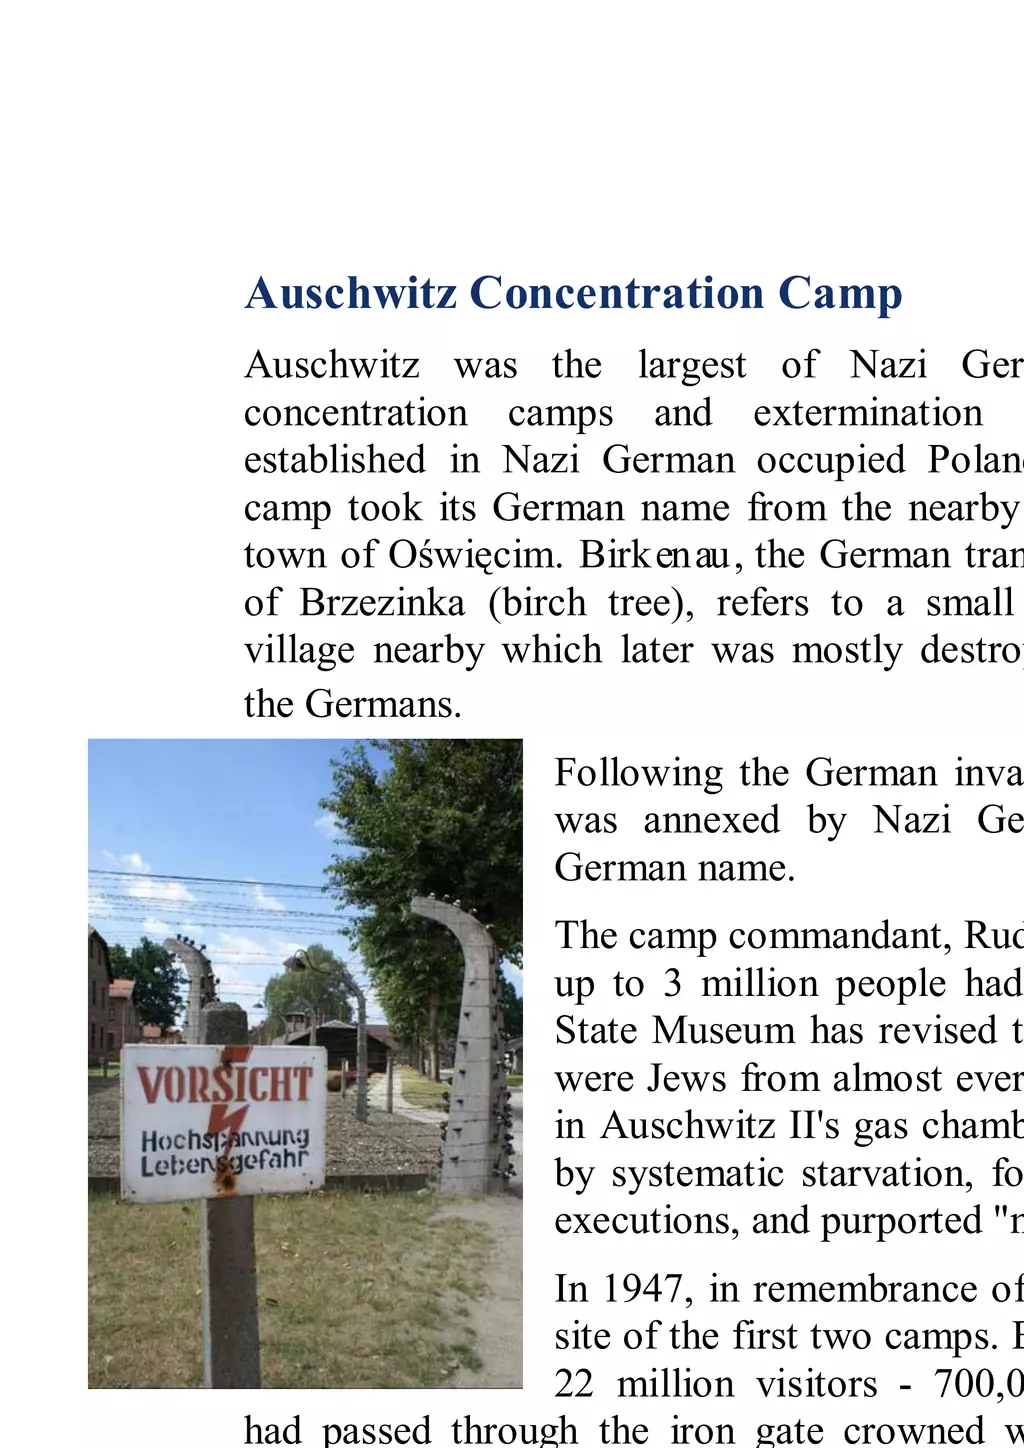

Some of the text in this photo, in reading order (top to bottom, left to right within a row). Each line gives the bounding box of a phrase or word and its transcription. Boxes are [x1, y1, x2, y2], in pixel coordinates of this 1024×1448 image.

[243, 275, 902, 319] Auschwitz Concentration Camp
[243, 348, 420, 379] Auschwitz
[453, 357, 518, 379] was
[551, 348, 602, 379] the
[638, 348, 747, 387] largest
[782, 348, 822, 379] of
[848, 348, 927, 379] Nazi
[244, 395, 469, 427] concentration
[508, 405, 614, 435] camps
[654, 396, 713, 427] and
[754, 395, 984, 427] extermination
[244, 443, 427, 474] established
[450, 443, 481, 474] in
[501, 443, 580, 474] Nazi
[602, 443, 736, 474] German
[757, 443, 907, 482] occupied
[243, 542, 327, 569] town
[341, 538, 381, 569] of
[389, 538, 563, 576] Oświęcim.
[579, 538, 743, 575] Birkenau,
[754, 538, 805, 569] the
[820, 538, 952, 569] German
[243, 633, 355, 672] village
[373, 633, 486, 672] nearby
[501, 633, 603, 664] which
[621, 633, 695, 664] later
[710, 642, 775, 664] was
[792, 633, 904, 672] mostly
[243, 687, 461, 719] the Germans.
[554, 756, 724, 795] Following
[739, 756, 789, 787] the
[806, 756, 938, 787] German
[554, 851, 795, 882] German name.
[554, 918, 618, 950] The
[629, 928, 717, 958] camp
[729, 918, 952, 956] commandant,
[556, 1014, 638, 1045] State
[651, 1014, 797, 1045] Museum
[810, 1013, 864, 1045] has
[878, 1013, 998, 1045] revised
[136, 1065, 314, 1105] VORSICHT
[141, 1128, 311, 1153] Hochspannung
[554, 1108, 586, 1139] in
[599, 1108, 776, 1140] Auschwitz
[789, 1109, 840, 1140] II's
[853, 1118, 908, 1148] gas
[140, 1148, 311, 1178] Lebensgefahr
[555, 1203, 739, 1241] executions,
[752, 1203, 811, 1235] and
[820, 1203, 983, 1243] purported
[555, 1319, 611, 1350] site
[623, 1319, 663, 1350] of
[669, 1319, 719, 1350] the
[732, 1319, 799, 1350] first
[810, 1323, 872, 1350] two
[885, 1328, 998, 1359] camps.
[554, 1367, 594, 1398] 22
[617, 1367, 735, 1398] million
[755, 1367, 878, 1398] visitors
